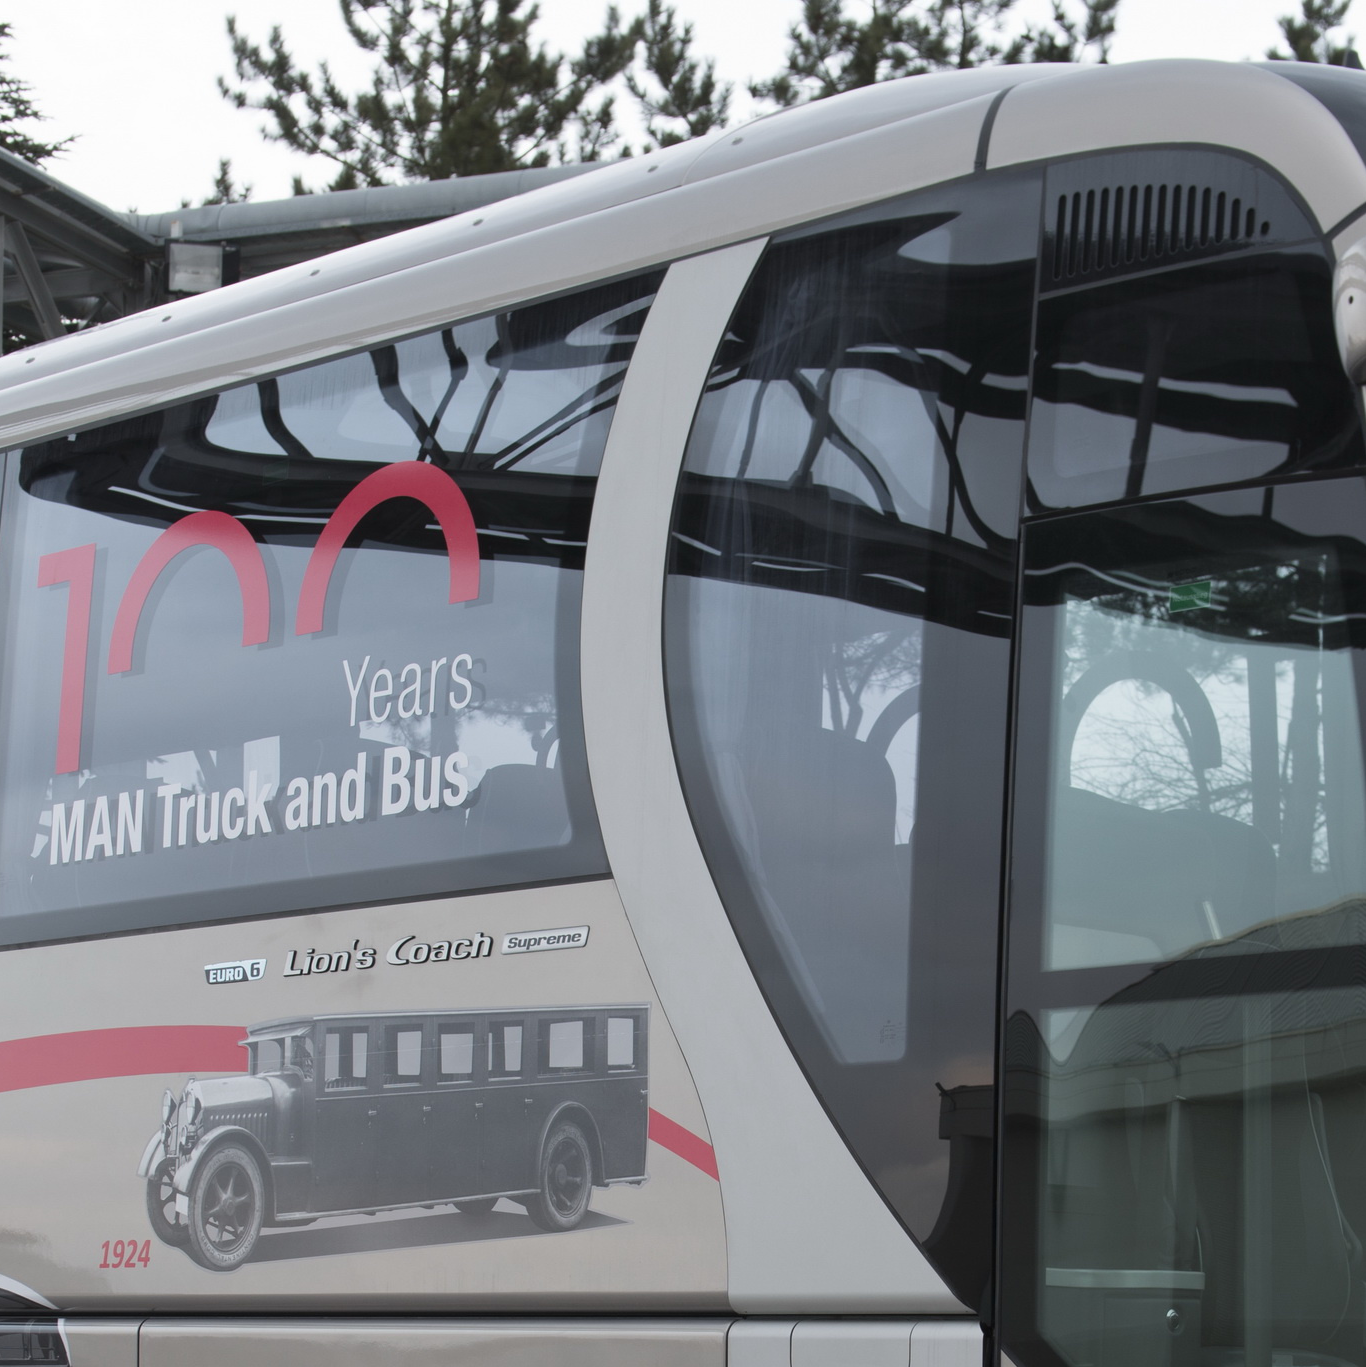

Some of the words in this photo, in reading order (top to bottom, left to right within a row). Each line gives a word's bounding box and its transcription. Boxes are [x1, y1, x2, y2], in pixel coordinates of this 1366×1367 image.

[37, 461, 480, 774] 100
[343, 654, 473, 726] Years
[49, 789, 144, 865] MAN
[157, 770, 273, 848] Truck
[285, 751, 367, 831] and
[381, 745, 469, 816] Bus
[209, 967, 243, 982] EURO
[250, 961, 261, 978] 6
[283, 939, 377, 977] Lion's
[386, 932, 494, 966] Coach
[507, 931, 582, 951] Supreme
[99, 1239, 151, 1269] 1924
